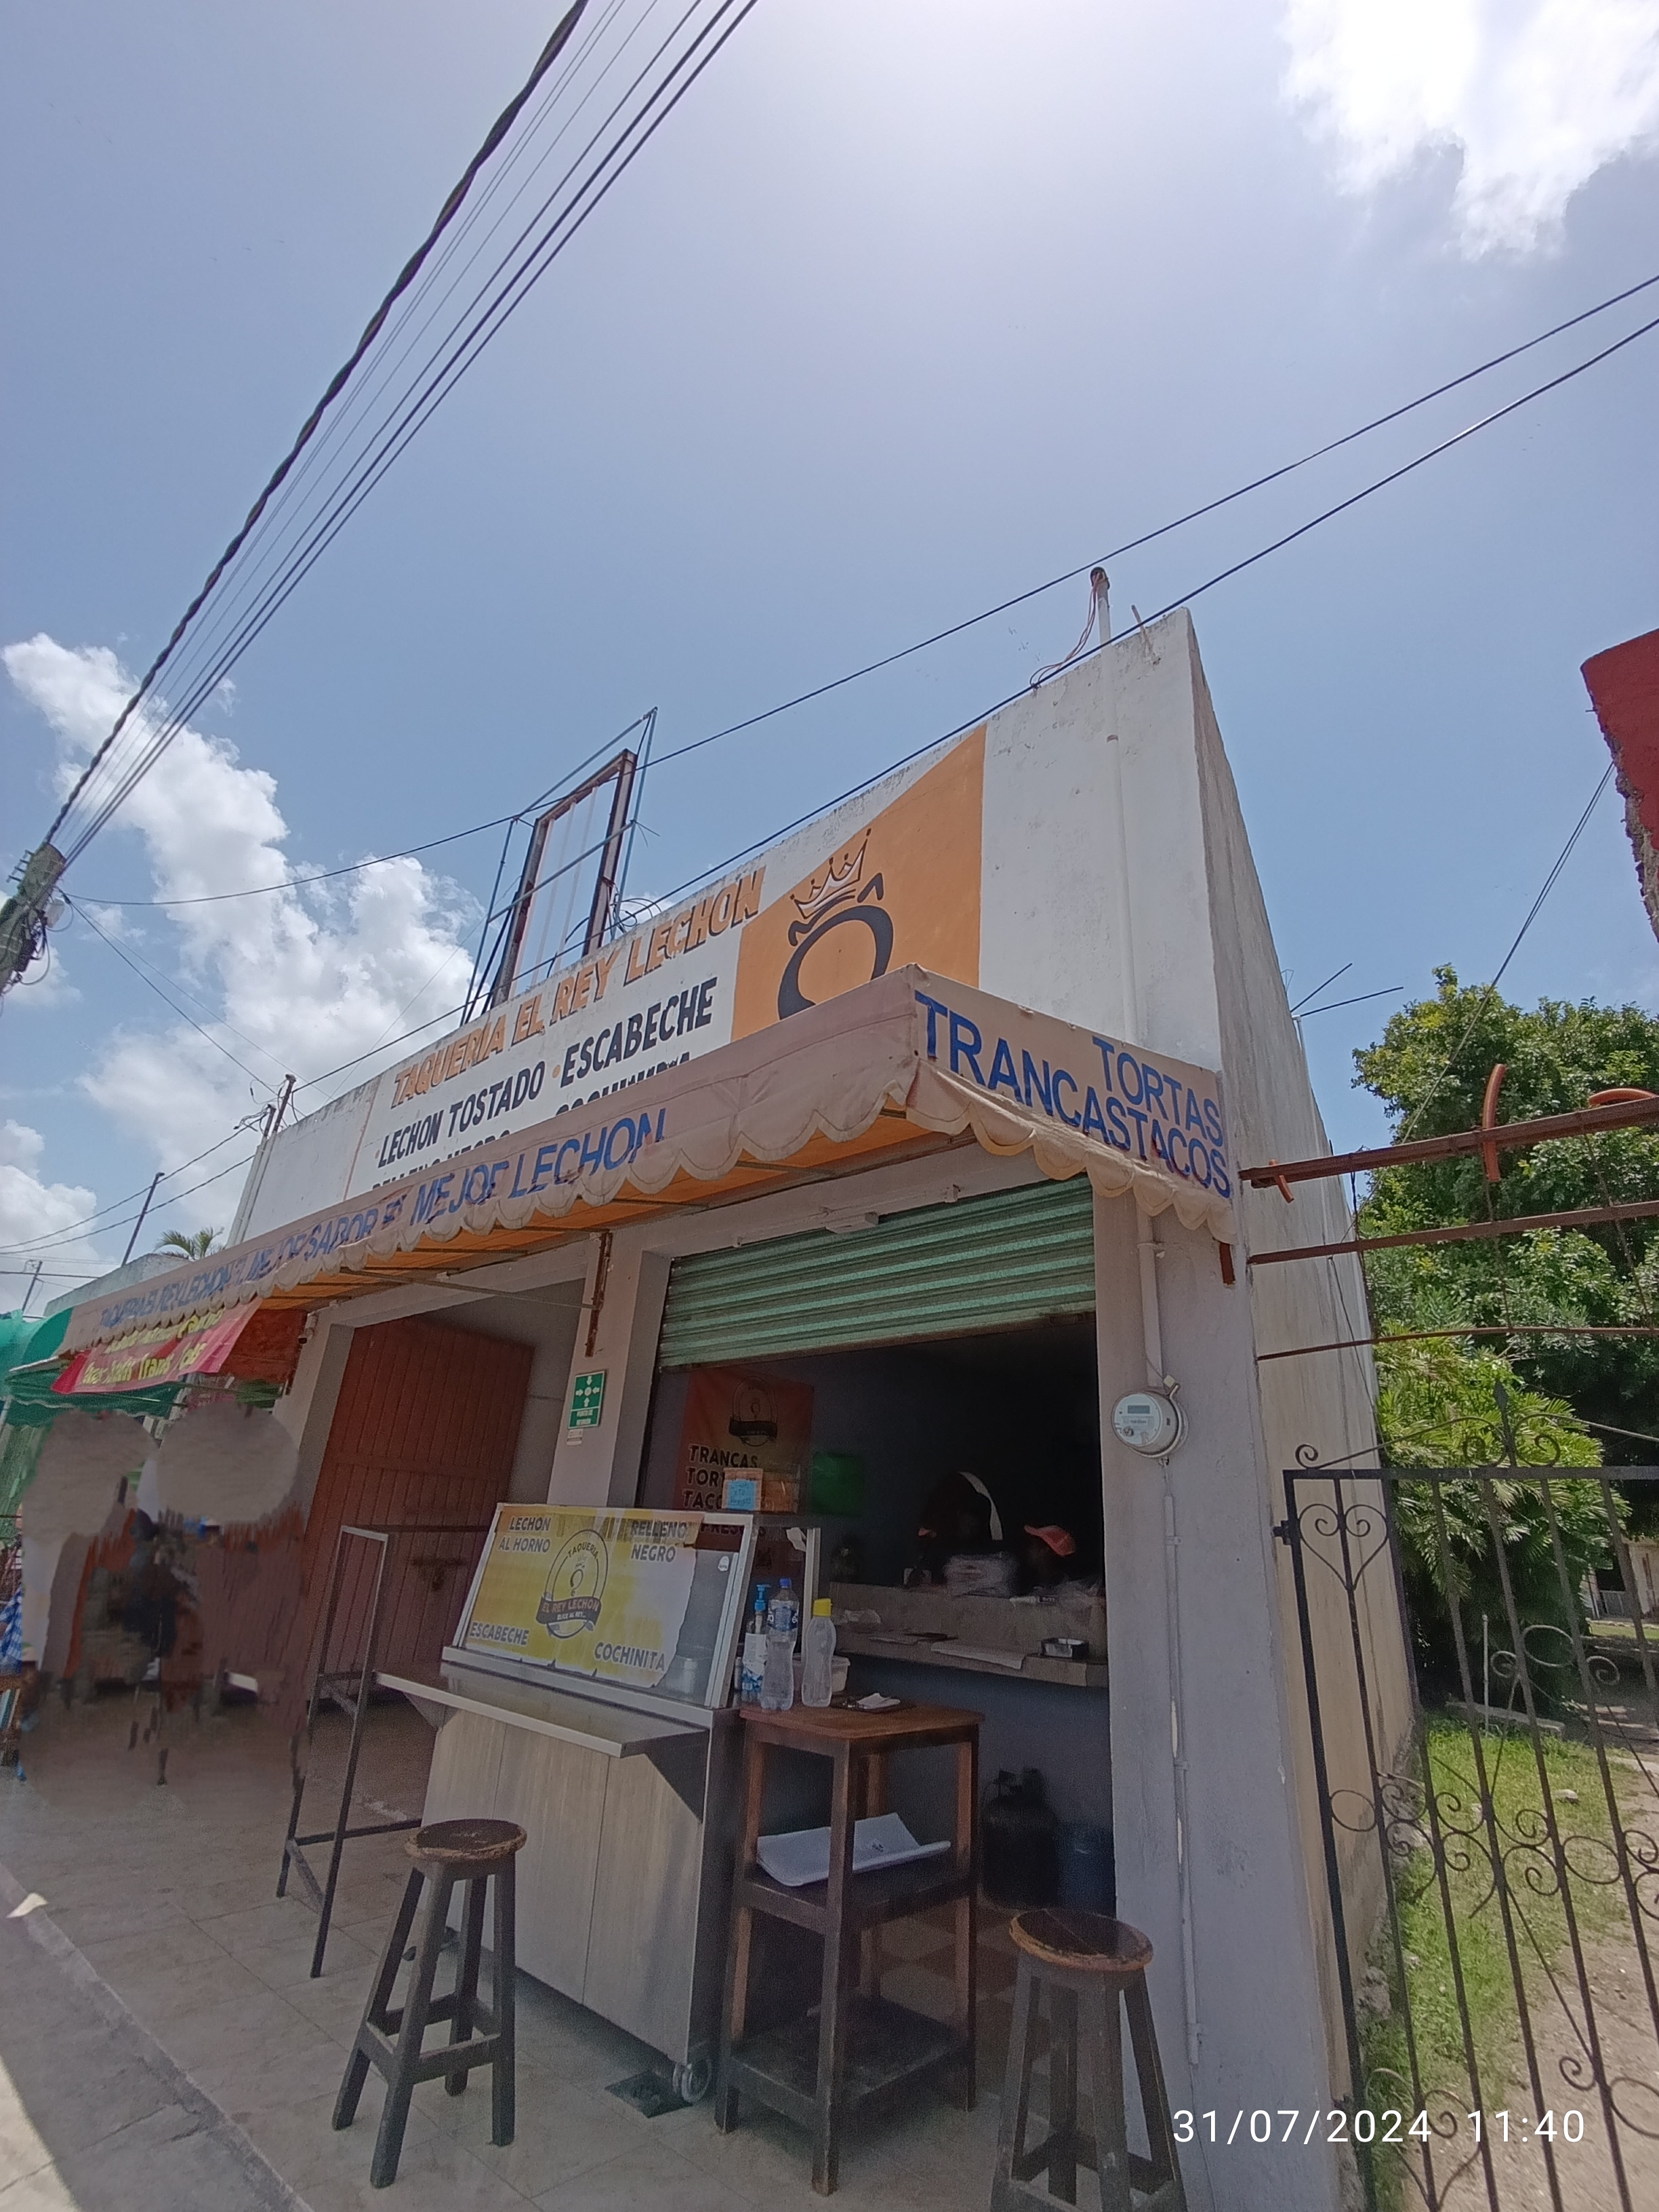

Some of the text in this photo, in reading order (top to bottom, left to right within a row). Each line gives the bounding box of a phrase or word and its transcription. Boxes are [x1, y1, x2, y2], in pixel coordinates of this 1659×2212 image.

[391, 1019, 506, 1109] TAQUERIA
[512, 997, 545, 1046] EL
[550, 951, 618, 1025] REY
[623, 865, 766, 987] LECHON
[377, 1110, 444, 1168] LECHON
[448, 1061, 546, 1139] TOSTADO
[560, 977, 718, 1088] ESCABECHE
[915, 990, 1231, 1199] TRANCAS TACOS
[1092, 1036, 1224, 1148] TORTAS
[508, 1107, 667, 1200] LECHON
[689, 1444, 758, 1469] TRANCAS
[687, 1467, 724, 1488] TOR
[510, 1516, 551, 1532] LECHON
[631, 1520, 687, 1538] RELLENO
[499, 1538, 550, 1553] AL HORNO
[568, 1542, 599, 1559] TAQUERIA
[631, 1544, 676, 1562] NEGRO
[552, 1601, 567, 1613] REY
[568, 1598, 599, 1612] LECHON
[470, 1622, 529, 1646] ESCABECHE
[594, 1641, 665, 1671] COCHINITA
